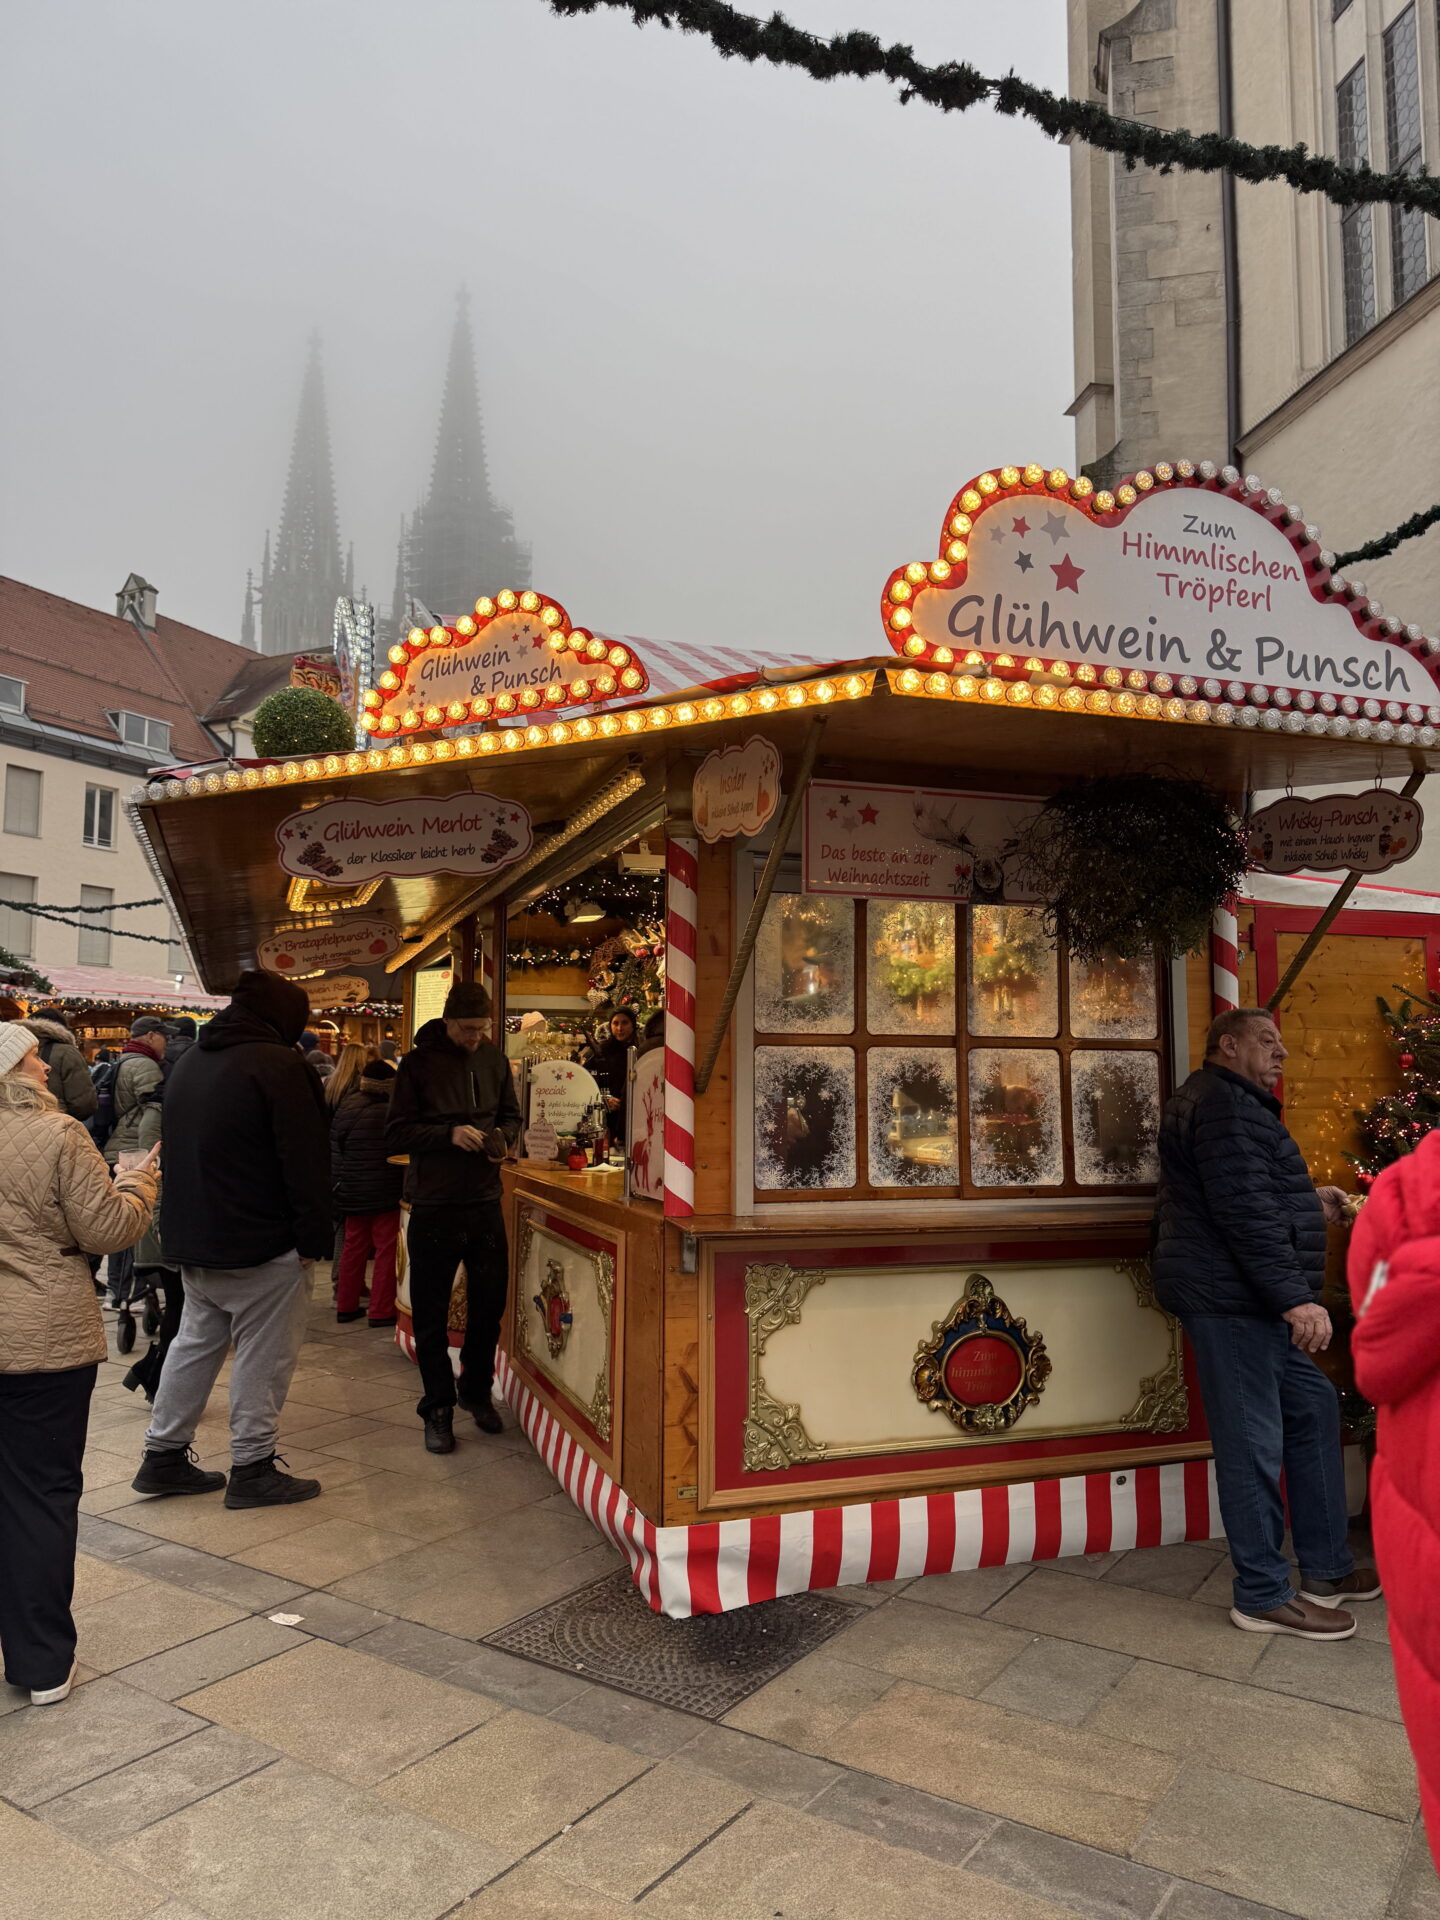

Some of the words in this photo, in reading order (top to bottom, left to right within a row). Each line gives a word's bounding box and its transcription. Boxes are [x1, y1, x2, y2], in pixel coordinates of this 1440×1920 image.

[1182, 513, 1237, 541] Zum
[1122, 532, 1302, 583] Himmlischen
[1156, 572, 1272, 613] Tröpferl
[948, 594, 1191, 665] Glühwein
[1205, 628, 1243, 673] &
[1256, 636, 1411, 693] Punsch
[420, 644, 512, 682] Glühwein
[470, 676, 486, 696] &
[491, 659, 563, 690] Punsch
[719, 766, 747, 796] Insider
[323, 817, 414, 843] Glühwein
[422, 813, 483, 835] Merlot
[1278, 806, 1379, 833] Whisky-Punsch
[1295, 836, 1318, 847] einem
[1320, 834, 1345, 846] Hauch
[1347, 833, 1376, 848] Ingwer
[346, 851, 368, 866] der
[370, 846, 417, 864] Klassiker
[420, 846, 448, 860] leicht
[451, 843, 476, 857] herb
[820, 844, 846, 861] Das
[852, 844, 886, 863] beste
[891, 851, 908, 864] an
[914, 851, 937, 866] der
[1341, 848, 1369, 863] Whisky
[828, 866, 931, 888] Weihnachtszeit
[284, 930, 375, 953] Bratapfelpunsch
[535, 1085, 567, 1097] specials
